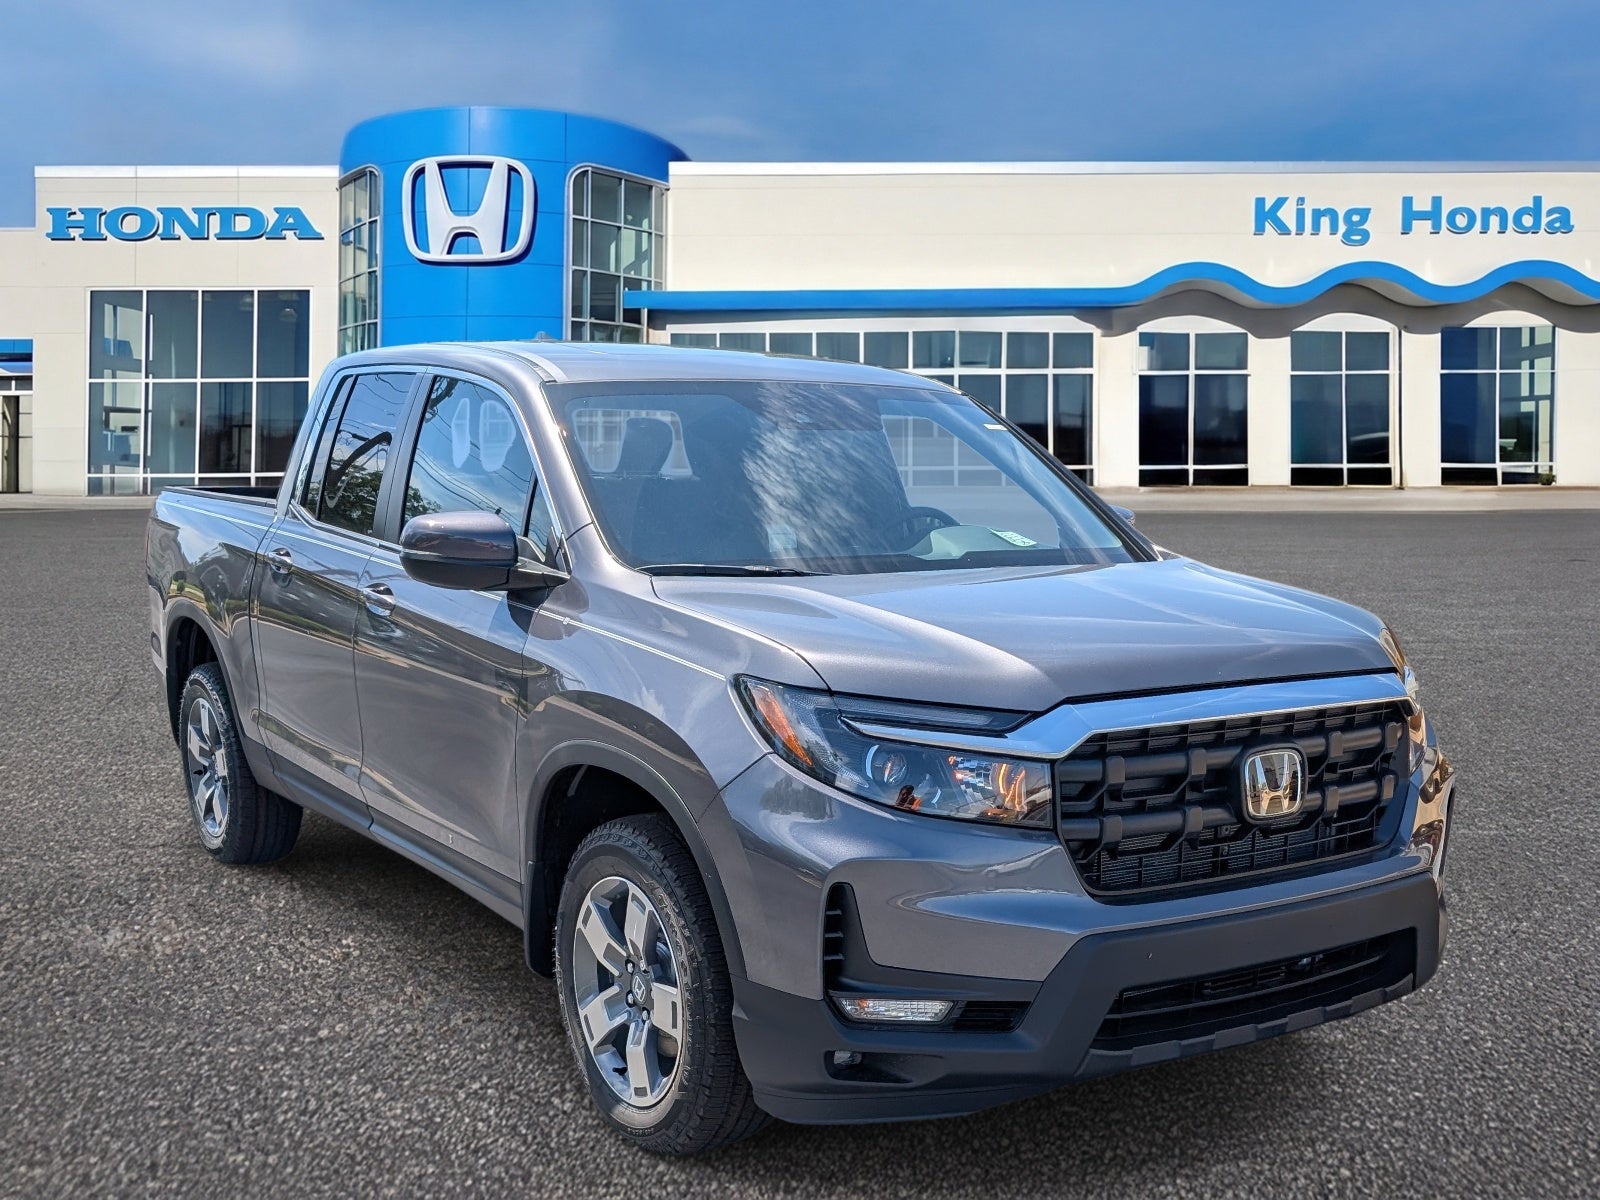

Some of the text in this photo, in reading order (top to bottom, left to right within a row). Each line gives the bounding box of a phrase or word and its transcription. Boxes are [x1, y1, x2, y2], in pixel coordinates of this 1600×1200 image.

[46, 206, 324, 240] HONDA
[1253, 195, 1575, 247] King Honda
